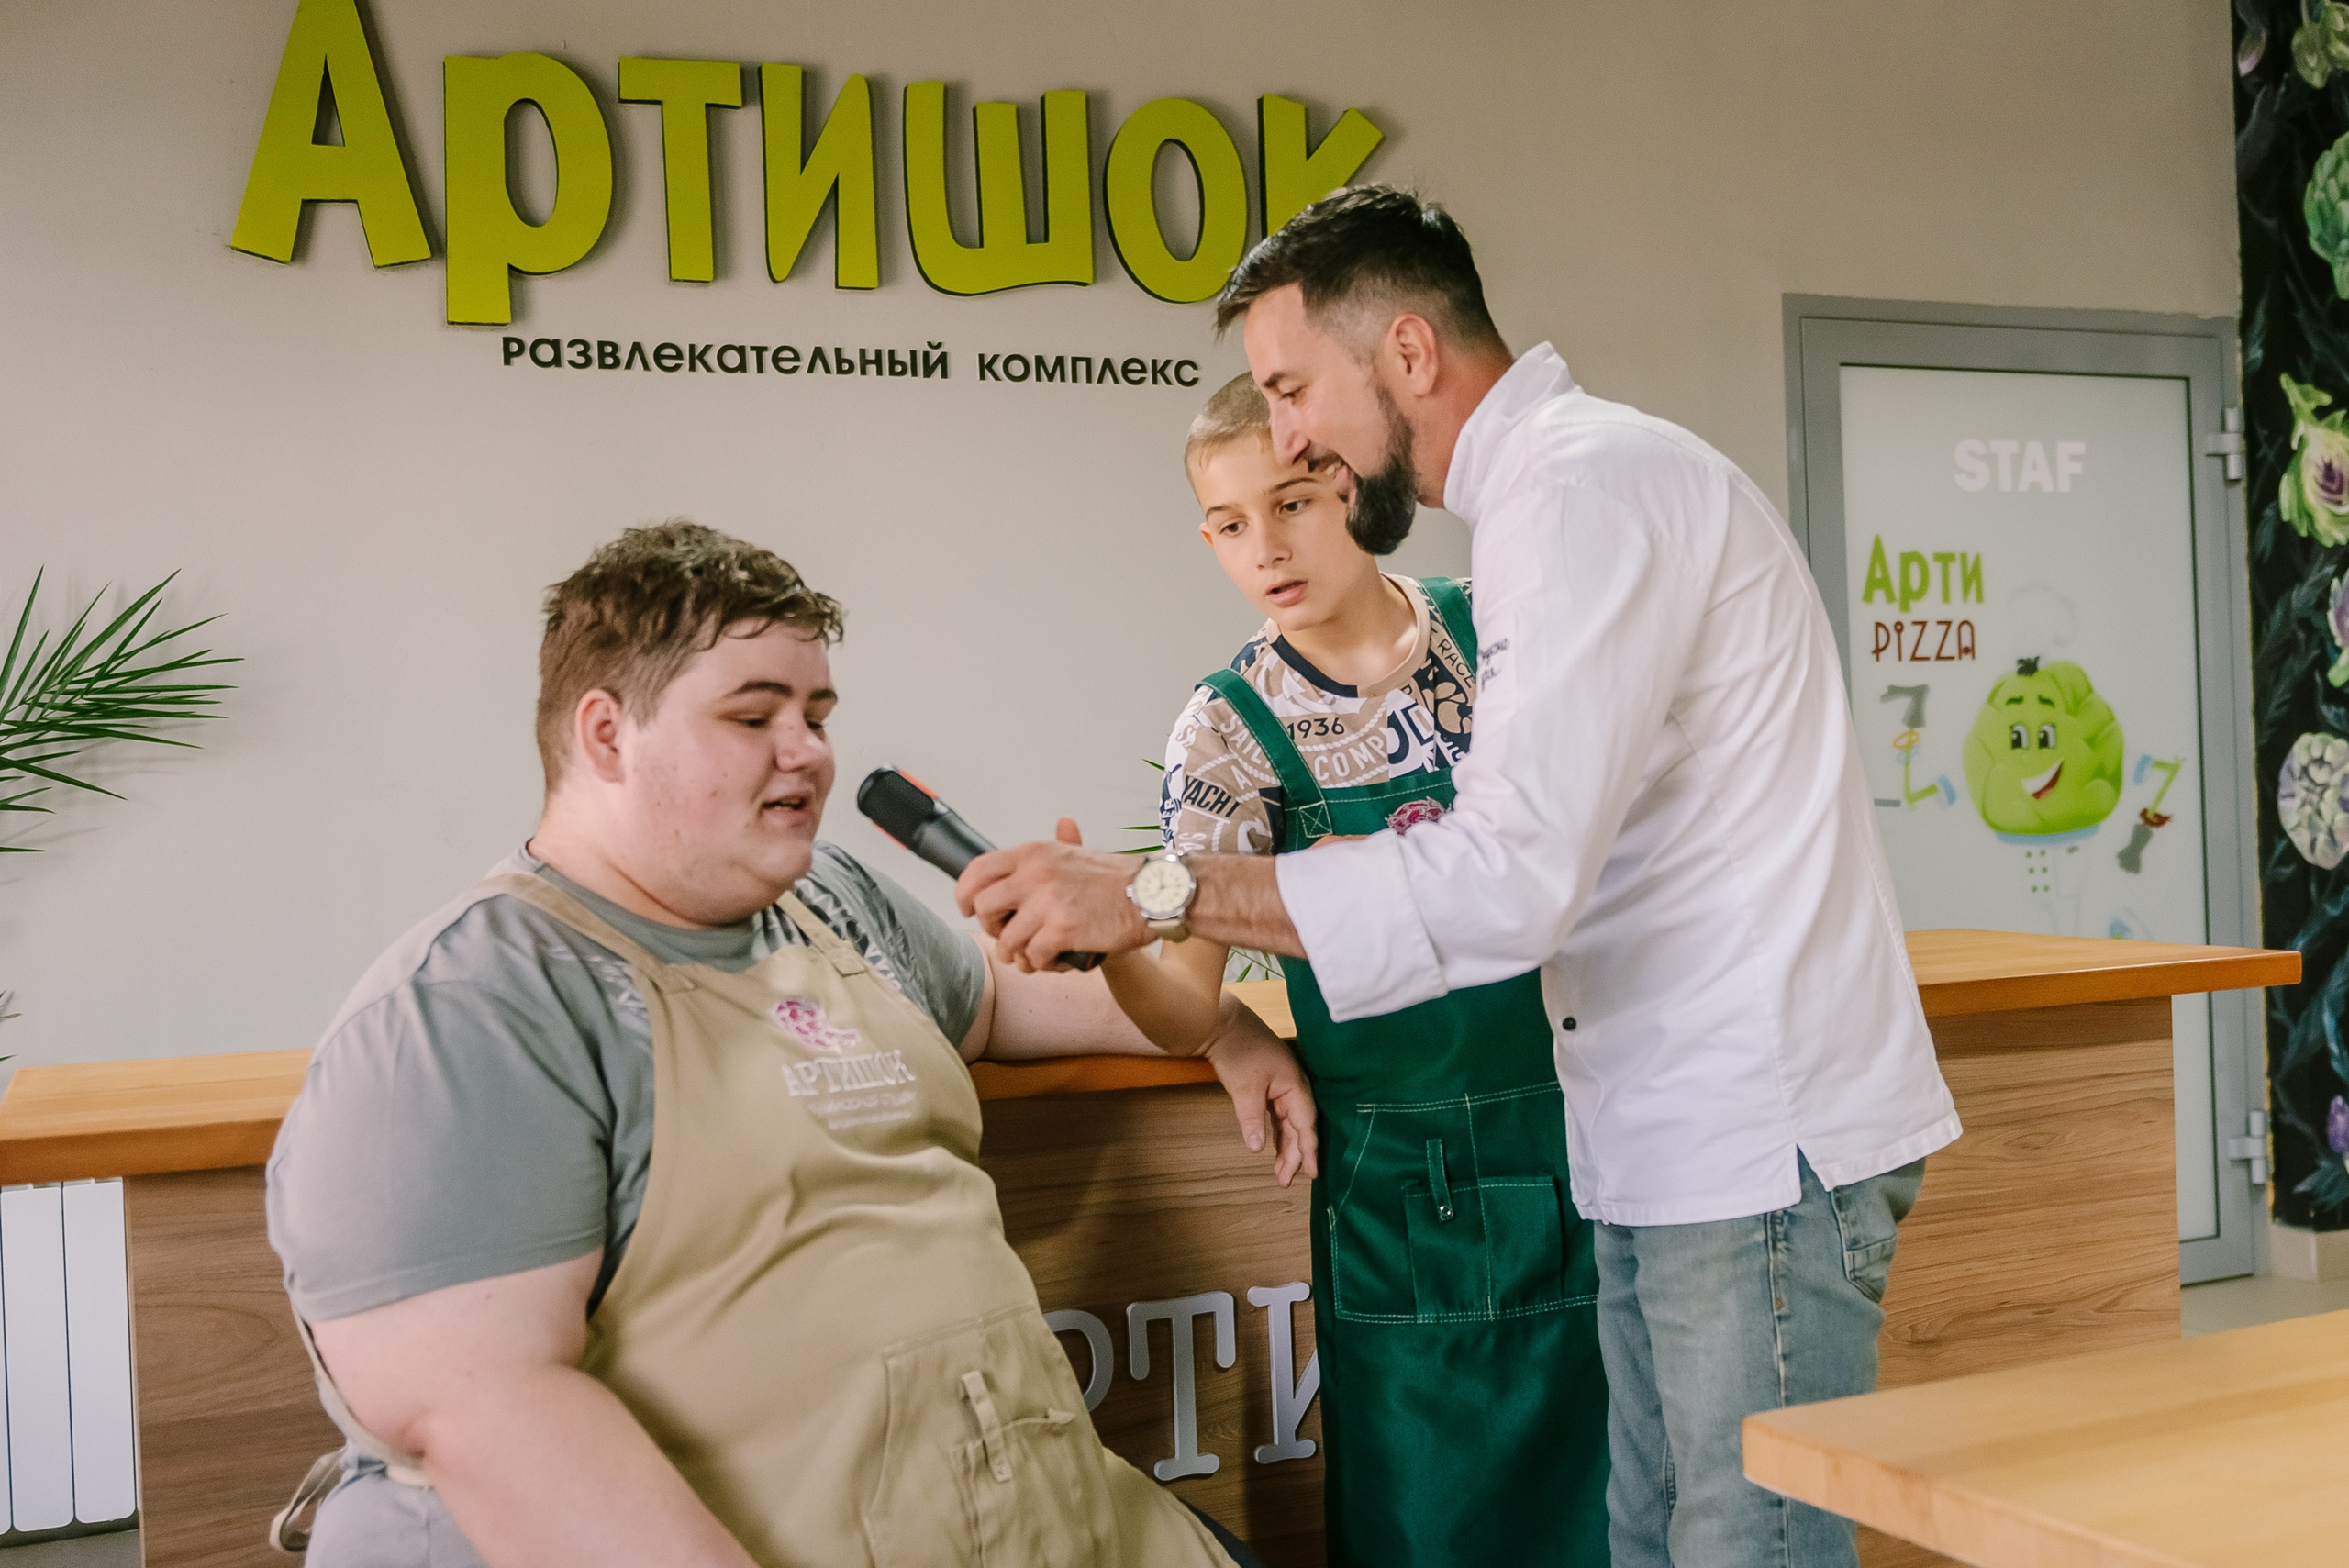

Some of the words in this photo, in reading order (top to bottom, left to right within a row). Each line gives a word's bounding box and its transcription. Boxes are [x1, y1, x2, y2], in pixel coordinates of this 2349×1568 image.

[977, 351, 1202, 387] комплекс
[1954, 439, 2086, 494] STAF
[1862, 533, 1984, 614] Арти
[1219, 714, 1272, 769] SAIL
[1286, 717, 1345, 741] 1936
